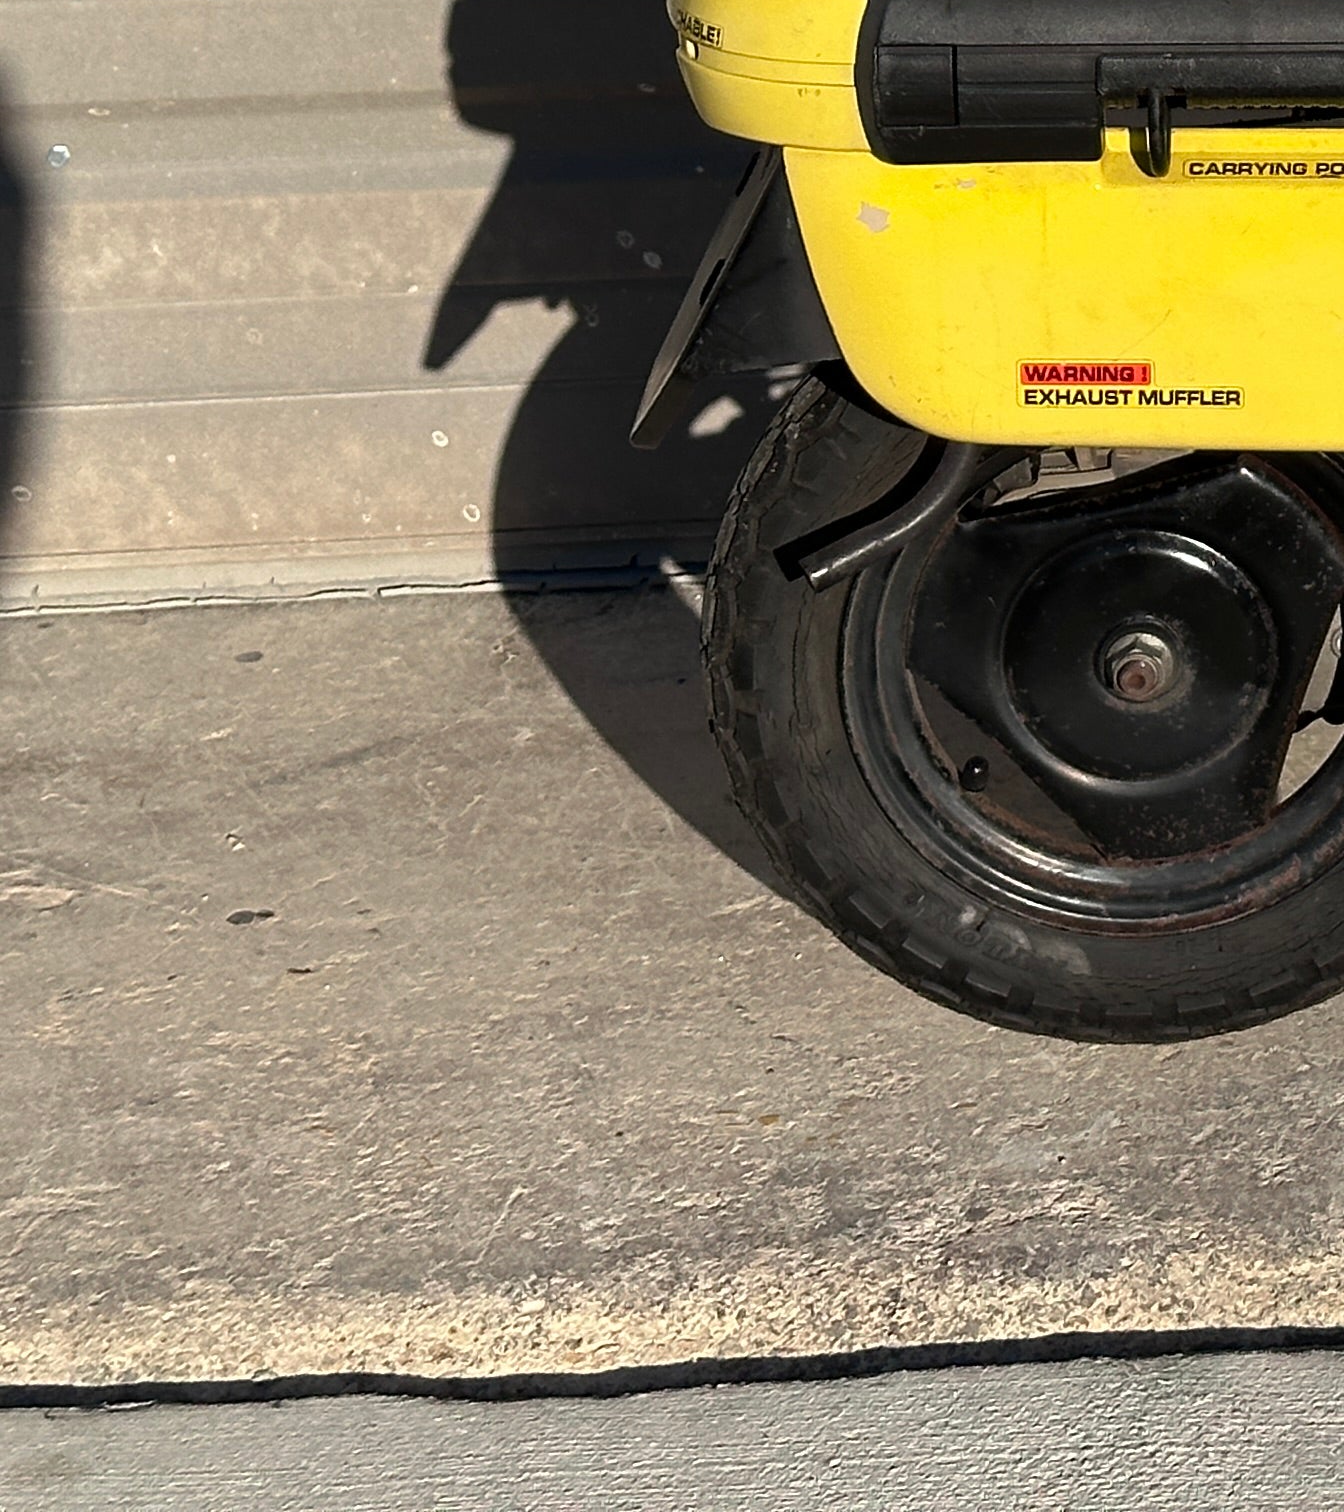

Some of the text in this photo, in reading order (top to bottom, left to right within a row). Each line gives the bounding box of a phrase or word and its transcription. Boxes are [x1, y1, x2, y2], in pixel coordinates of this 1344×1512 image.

[1188, 162, 1308, 176] CARRYING
[1023, 365, 1136, 382] WARNING
[1023, 388, 1242, 406] EXHAUST MUFFLER
